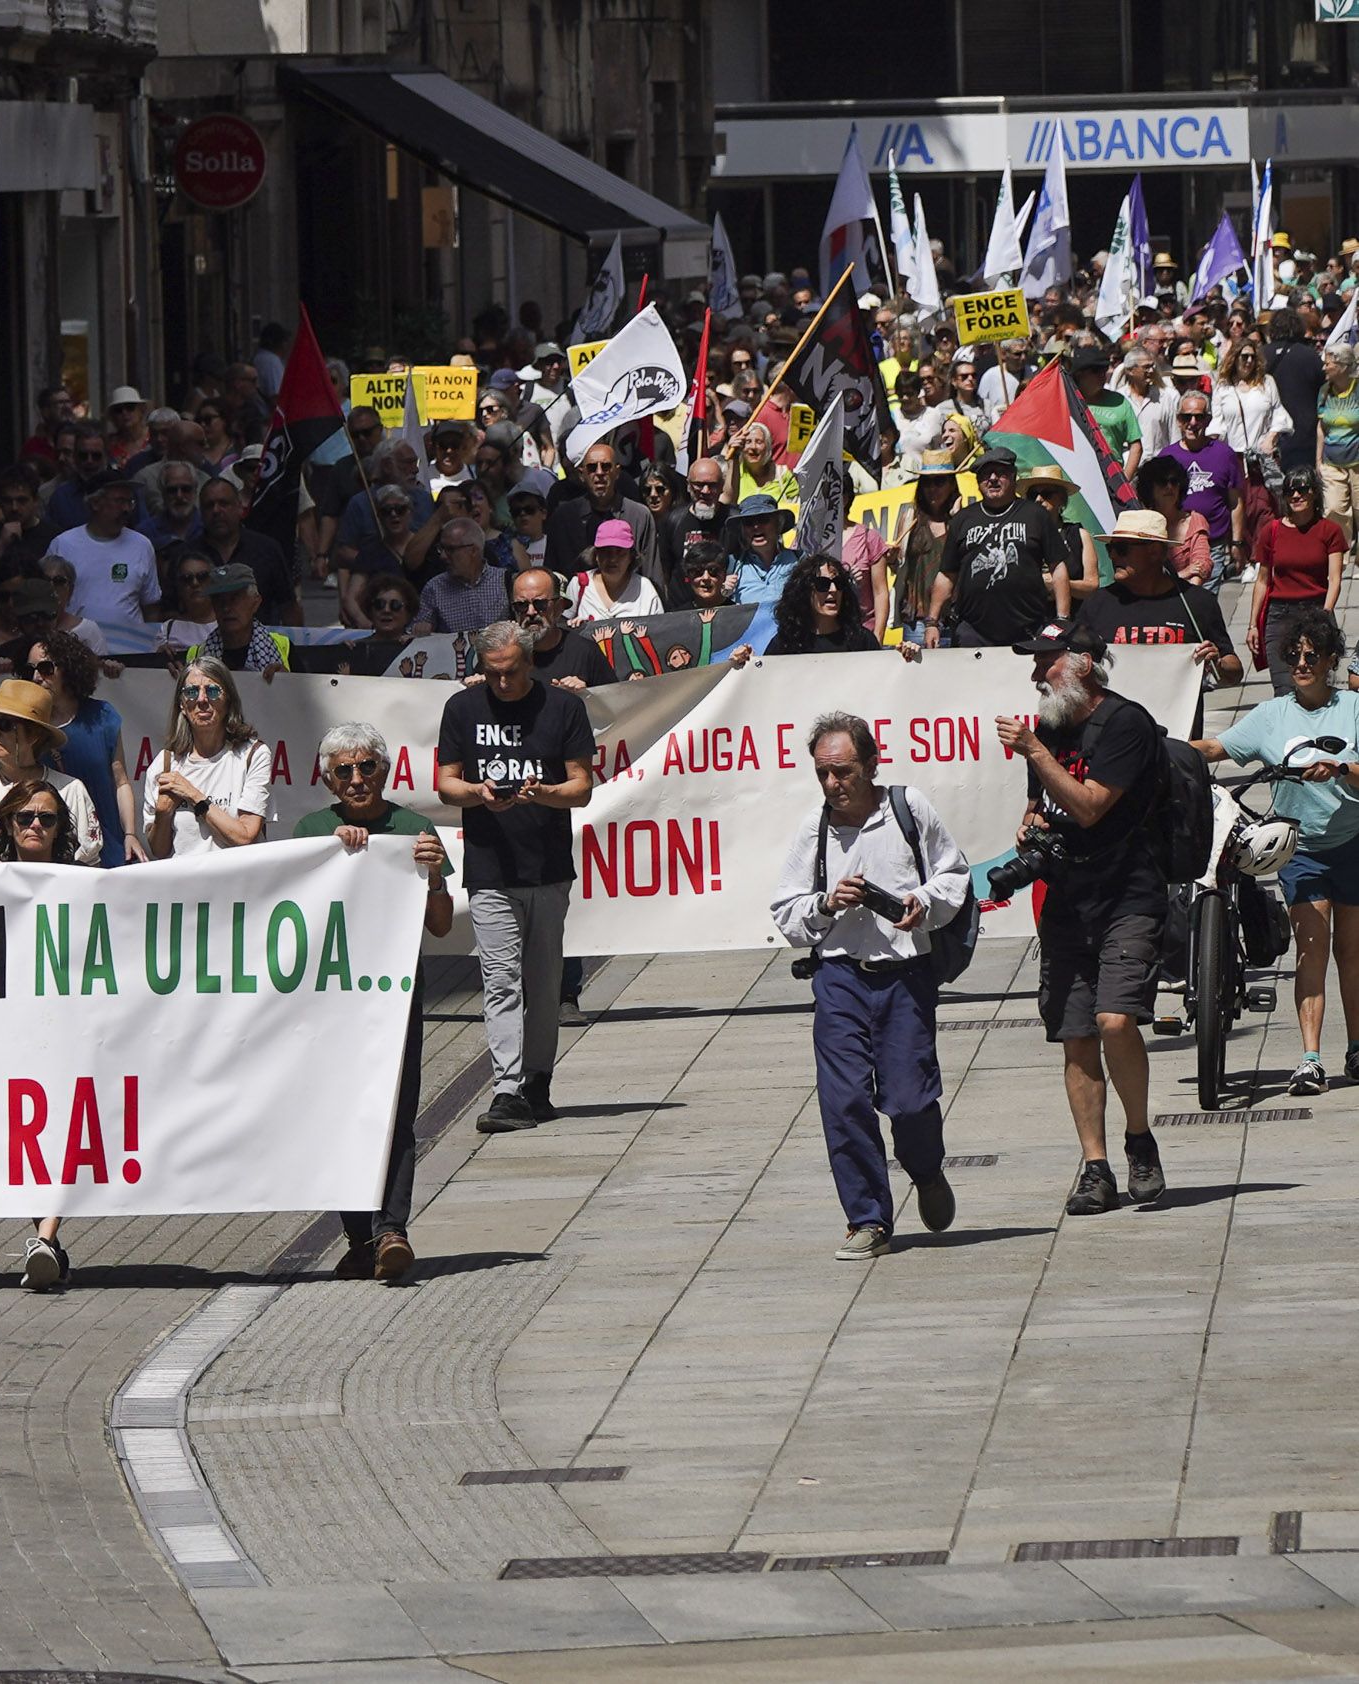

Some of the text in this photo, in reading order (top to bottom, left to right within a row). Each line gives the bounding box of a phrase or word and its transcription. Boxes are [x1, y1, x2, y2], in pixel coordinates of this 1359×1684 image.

[1045, 116, 1232, 164] ABANCA
[184, 150, 257, 173] Solla
[963, 294, 1017, 315] ENCE
[965, 311, 1021, 332] FÓRA
[366, 379, 408, 394] ALTR
[444, 375, 473, 386] NON
[433, 390, 465, 400] TOCA
[476, 724, 522, 746] ENCE
[663, 725, 760, 775] AUGA
[777, 723, 796, 769] E
[910, 716, 980, 763] SON
[477, 753, 544, 780] FÓRA!
[582, 817, 722, 899] NON!
[35, 903, 118, 996] NA
[145, 899, 412, 995] ULLOA...
